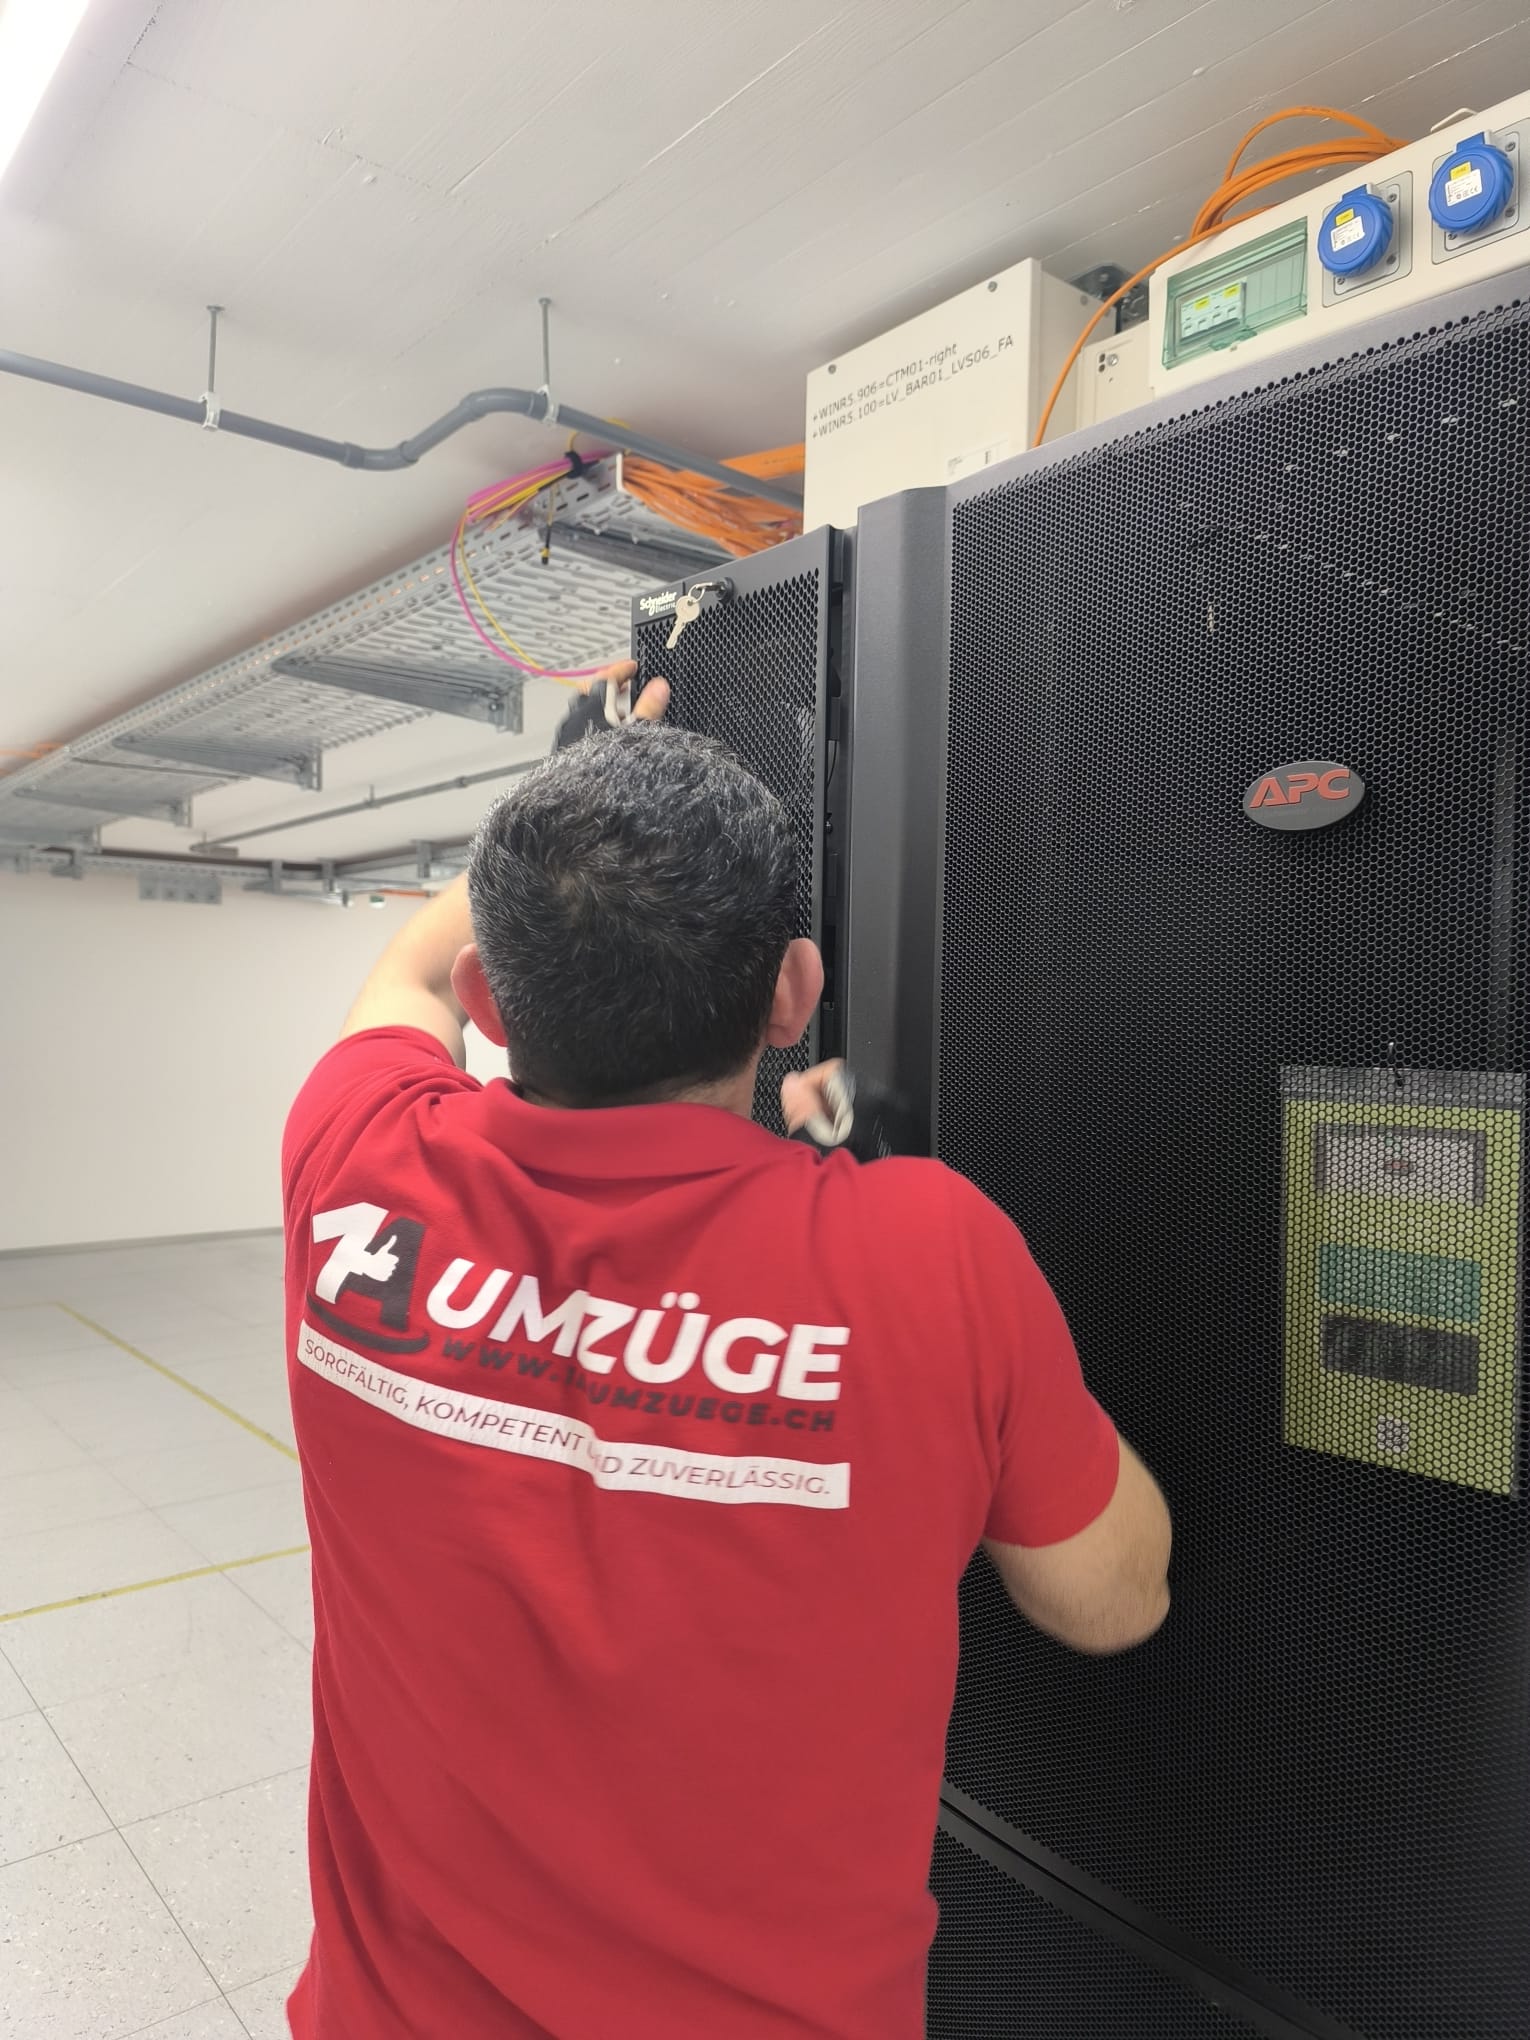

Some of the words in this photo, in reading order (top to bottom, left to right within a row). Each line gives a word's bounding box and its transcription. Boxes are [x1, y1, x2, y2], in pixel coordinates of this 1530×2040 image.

[1249, 768, 1350, 808] APC
[426, 1257, 850, 1401] UMZÜGE
[304, 1338, 410, 1410] SORGFÄLTIG,
[416, 1395, 586, 1452] KOMPETENT
[628, 1457, 832, 1495] ZUVERLÄSSIG.
